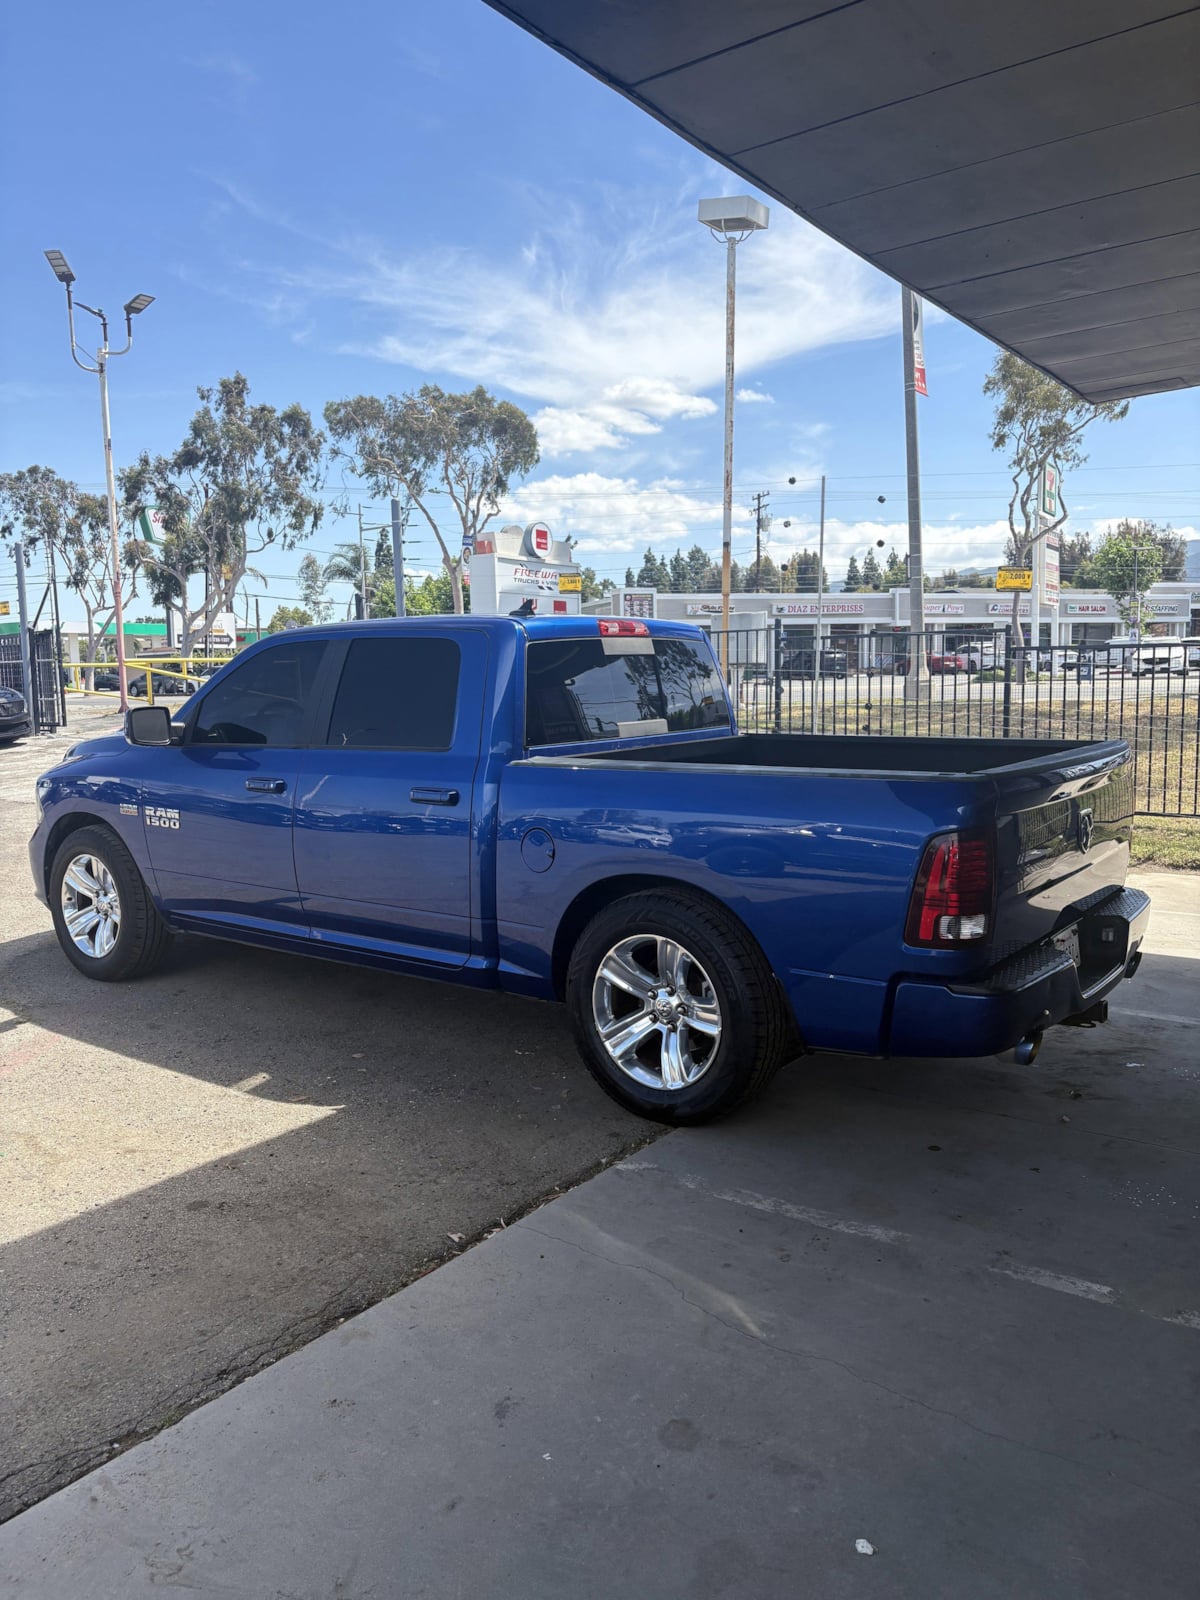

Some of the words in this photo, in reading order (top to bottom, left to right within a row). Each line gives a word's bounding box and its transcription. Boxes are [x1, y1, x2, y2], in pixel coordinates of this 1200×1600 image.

[514, 567, 559, 580] FREEWA
[513, 577, 540, 585] TRUCKS
[787, 605, 808, 613] DIAZ
[810, 604, 864, 613] ENTERPRISES
[1091, 605, 1106, 613] SALON
[144, 806, 180, 819] RAM
[145, 816, 180, 830] 1500
